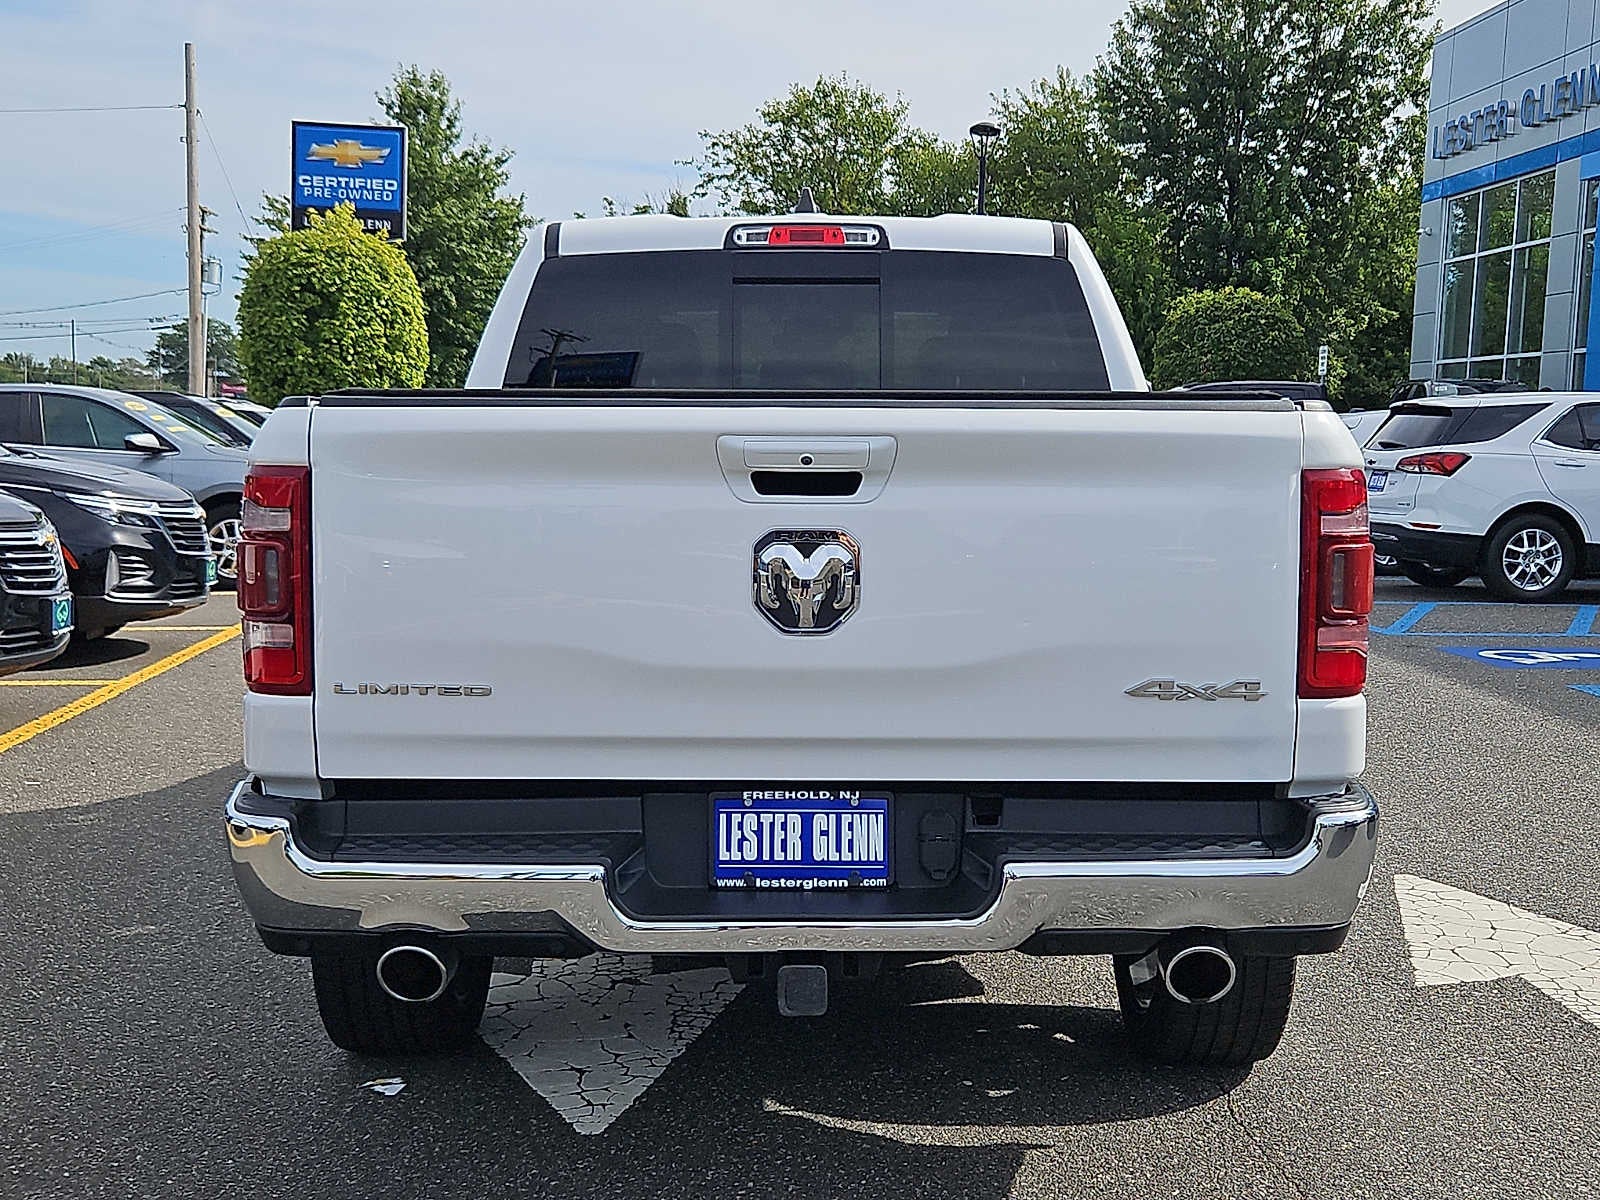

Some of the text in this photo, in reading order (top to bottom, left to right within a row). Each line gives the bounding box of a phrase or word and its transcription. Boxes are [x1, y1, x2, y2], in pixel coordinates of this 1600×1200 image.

[1432, 99, 1516, 159] LESTER
[298, 175, 398, 191] CERTIFIED
[304, 187, 392, 200] PRE-OWNED
[774, 530, 838, 541] RAM
[333, 682, 492, 697] LIMITED
[743, 791, 860, 800] FREEHOLD, NJ
[719, 813, 884, 862] LESTER GLENN
[755, 877, 849, 890] lesterglenn
